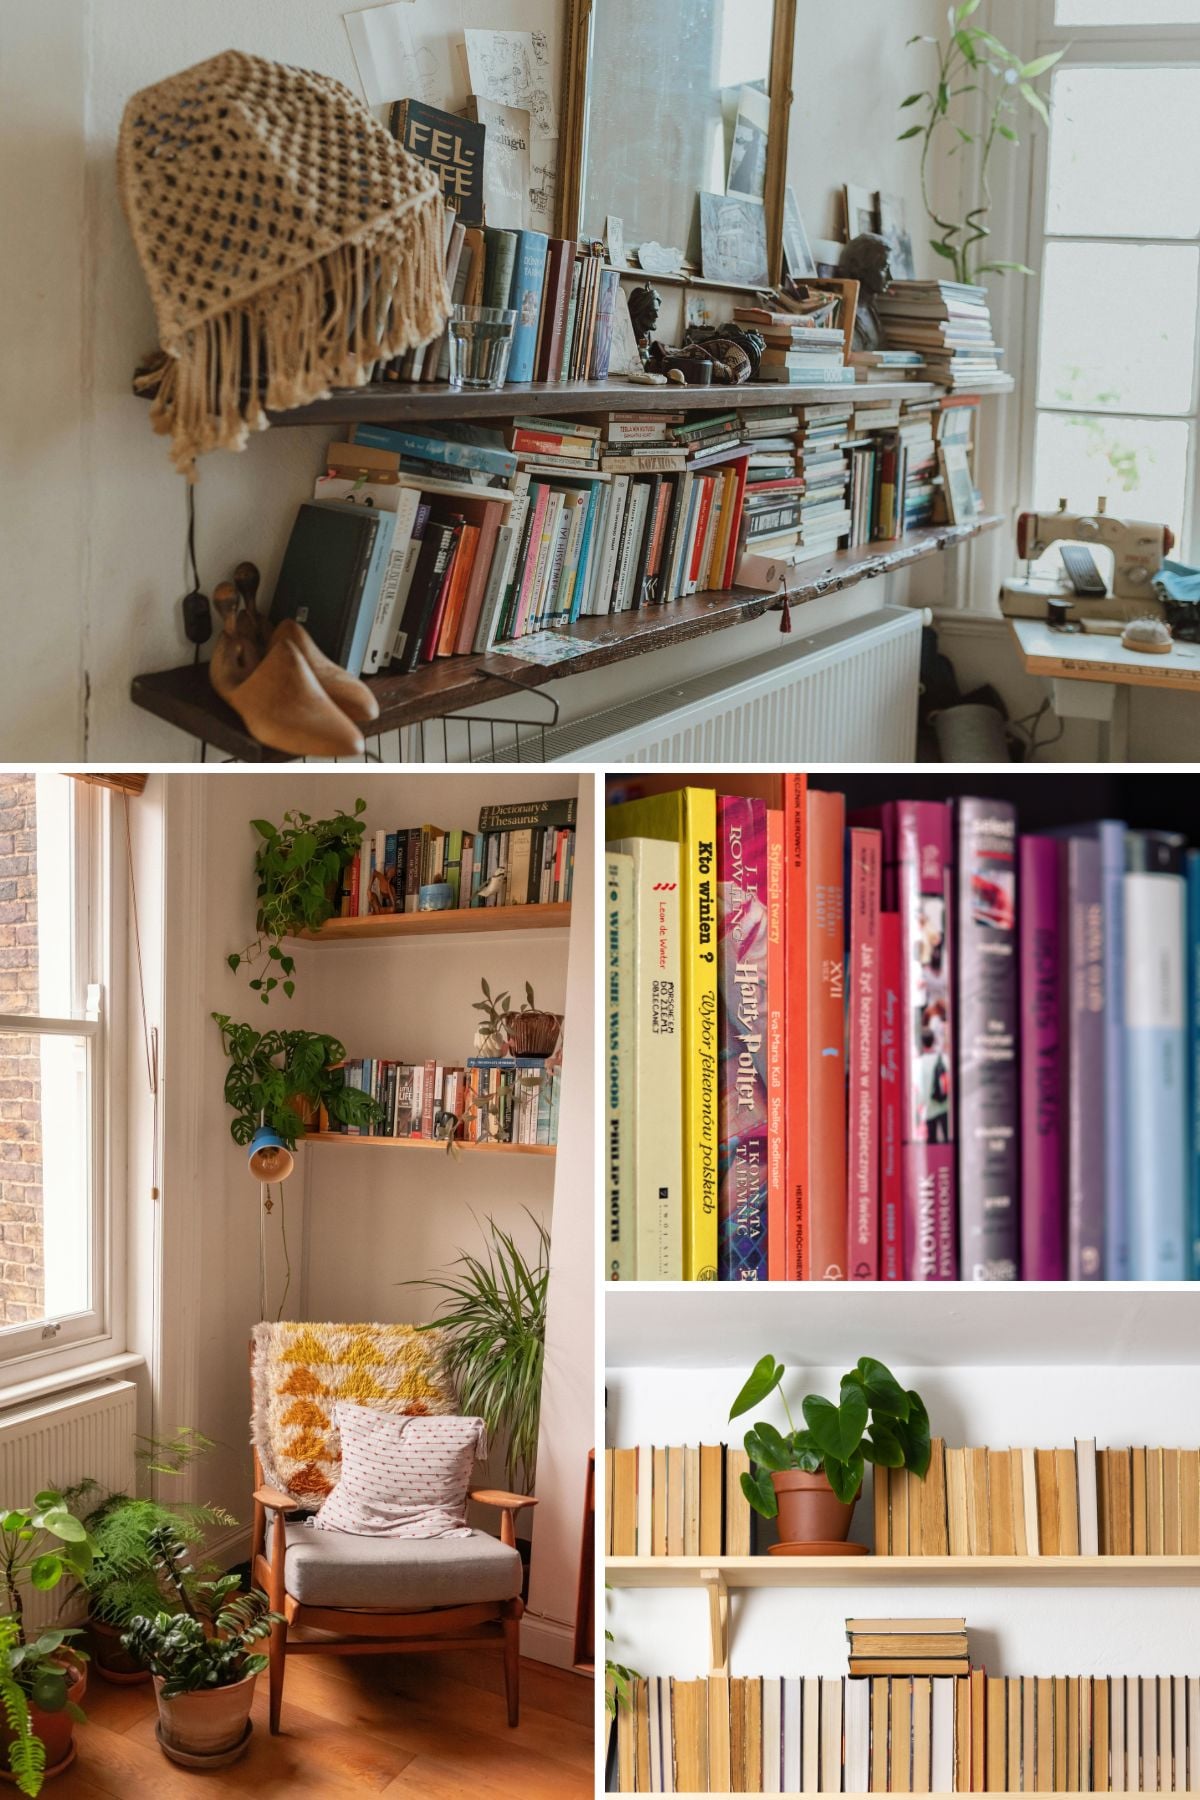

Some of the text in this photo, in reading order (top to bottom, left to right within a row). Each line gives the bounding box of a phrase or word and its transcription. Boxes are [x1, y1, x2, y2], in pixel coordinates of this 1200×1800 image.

[408, 120, 475, 167] FEL-
[489, 815, 540, 828] Thesaurus
[492, 804, 542, 816] Dictionary
[699, 841, 714, 963] Kto winien ?
[730, 824, 744, 944] ROWLING
[744, 864, 758, 877] J.
[768, 843, 782, 944] Stylizacja twarzy
[659, 902, 668, 970] Leon de Winter
[830, 960, 842, 998] XVII
[610, 911, 620, 1109] WHEN SHE WAS GOOD
[660, 981, 668, 996] DO
[732, 958, 762, 1114] Harry Potter
[770, 1010, 780, 1062] Eva-Maria
[698, 990, 716, 1214] Wybór felietonów polskich
[858, 943, 874, 1244] Jak żyć bezpiecznie w niebezpiecznym świecie
[610, 1119, 620, 1242] PHILIP ROTH
[769, 1096, 780, 1190] Shelley Sedlmaier
[736, 1144, 748, 1236] TAJEMNIC
[748, 1152, 760, 1238] KOMNATA
[918, 1173, 937, 1276] SŁOWNIK
